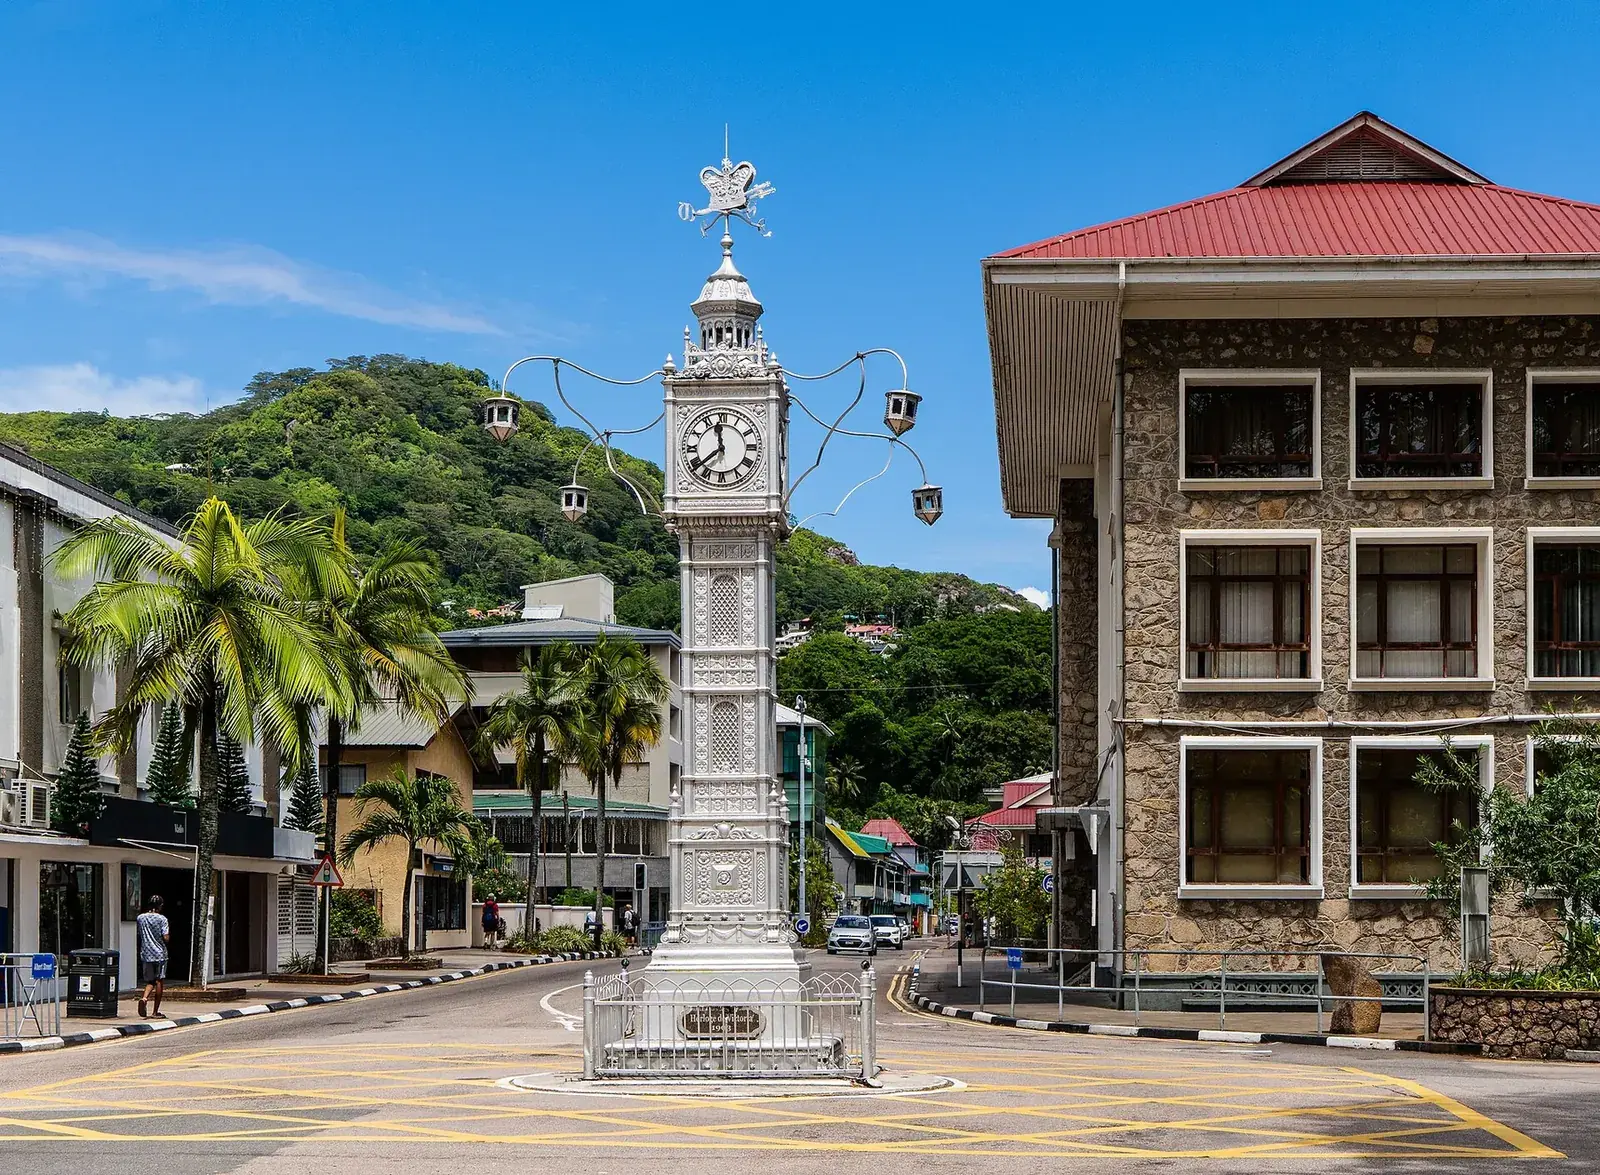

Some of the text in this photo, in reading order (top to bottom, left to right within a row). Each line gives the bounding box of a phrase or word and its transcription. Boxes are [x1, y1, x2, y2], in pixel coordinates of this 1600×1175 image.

[702, 417, 713, 428] XI
[717, 413, 728, 424] XII
[734, 417, 740, 426] I
[691, 429, 702, 438] X
[742, 428, 753, 437] II
[687, 444, 698, 453] IX
[701, 467, 712, 480] VII
[717, 472, 726, 483] VI
[733, 468, 742, 479] V
[726, 1013, 753, 1022] Vitora
